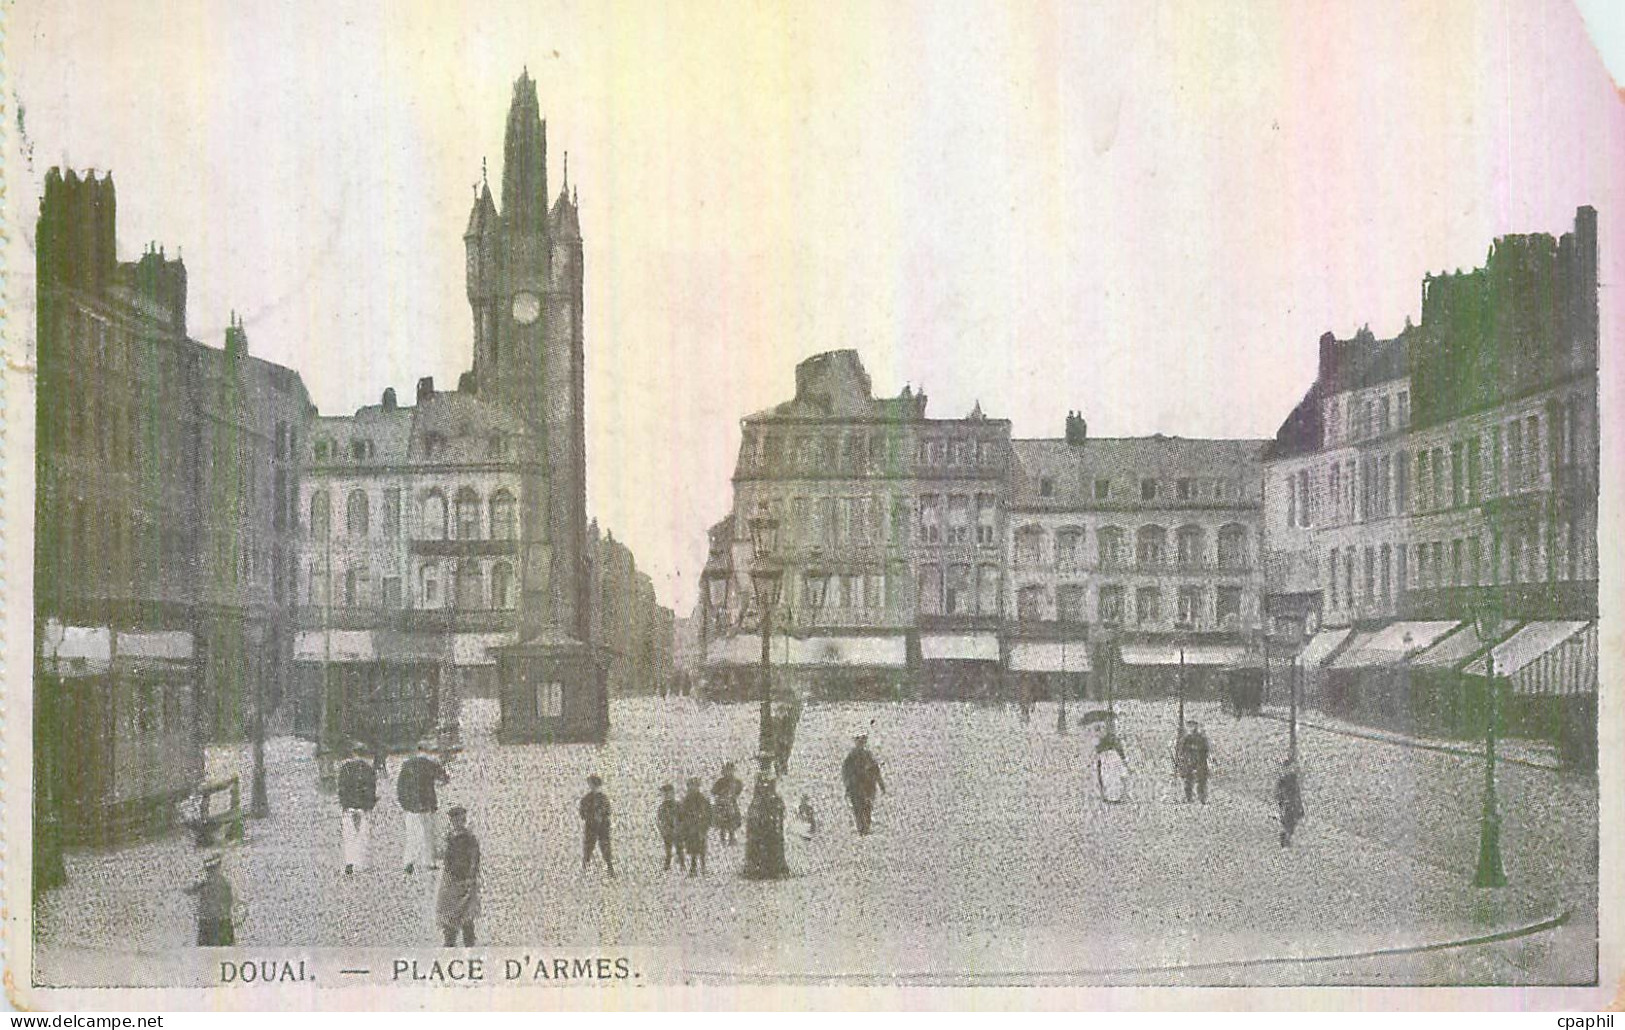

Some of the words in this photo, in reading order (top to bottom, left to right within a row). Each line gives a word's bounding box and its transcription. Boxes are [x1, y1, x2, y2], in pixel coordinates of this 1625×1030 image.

[220, 961, 316, 982] DOUAI.
[392, 960, 483, 981] PLACE
[505, 956, 641, 980] D'ARMES.
